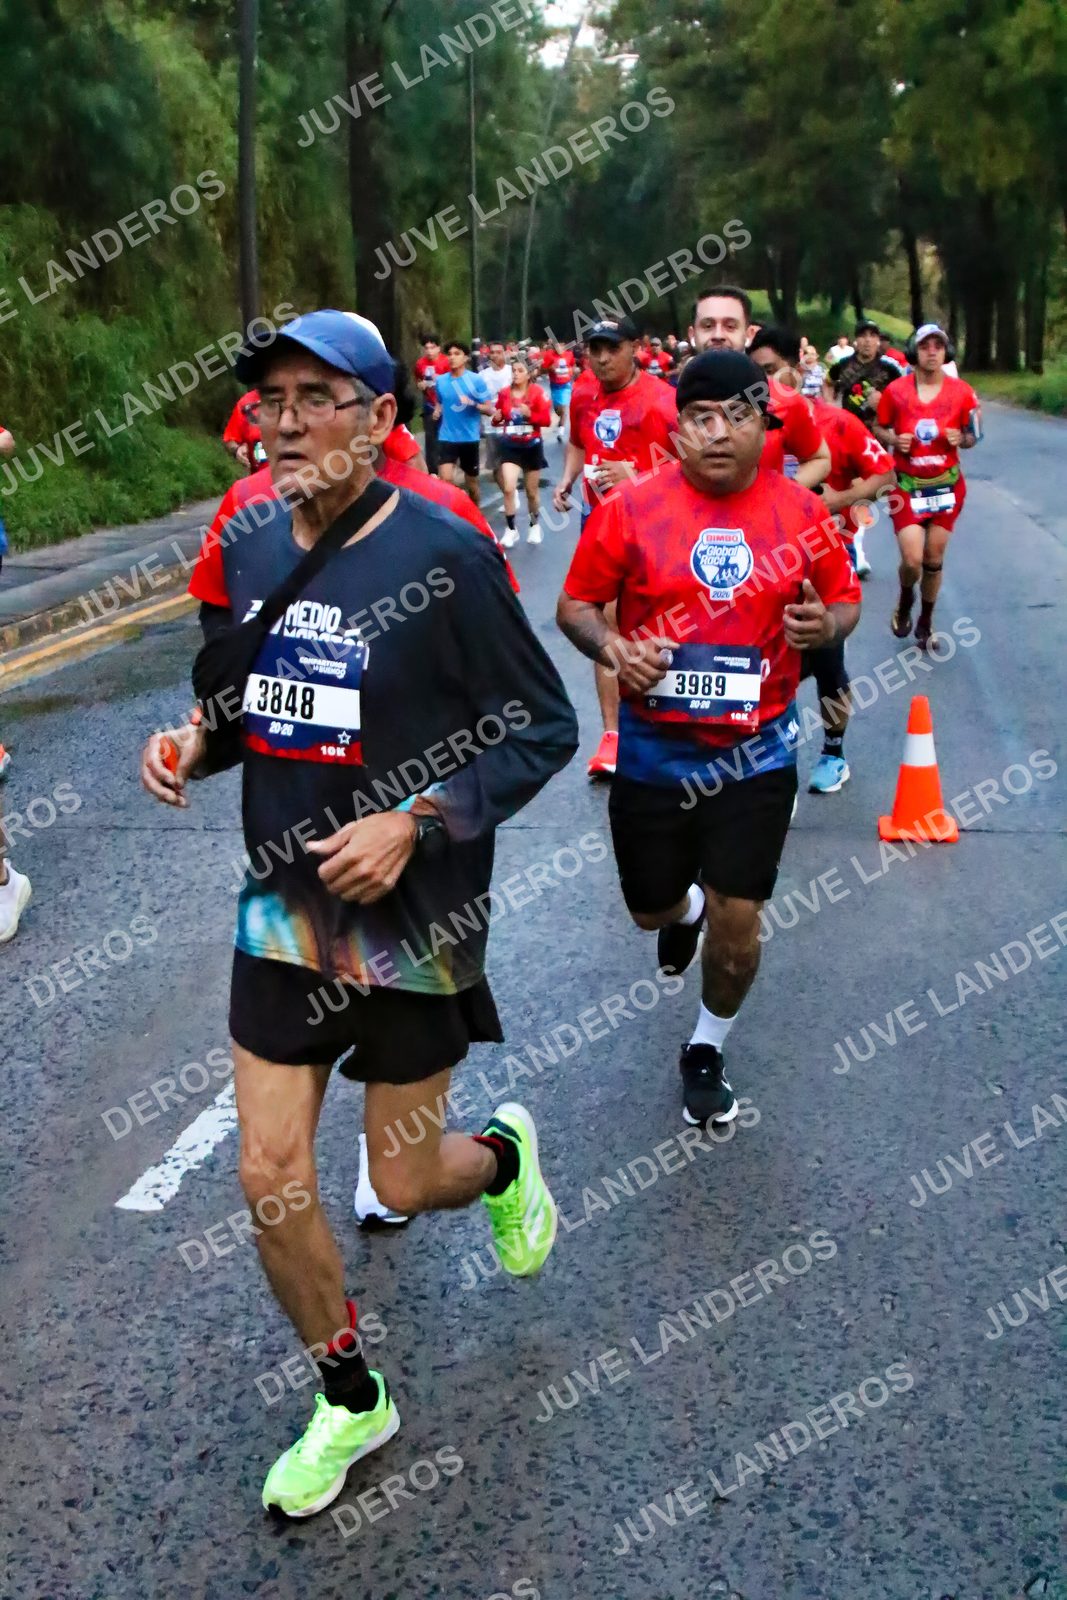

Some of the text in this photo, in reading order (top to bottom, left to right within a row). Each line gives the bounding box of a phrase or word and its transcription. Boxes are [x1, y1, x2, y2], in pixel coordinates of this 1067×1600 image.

[706, 545, 738, 556] Global
[700, 555, 726, 566] Race
[285, 600, 342, 634] MEDIO
[675, 673, 727, 696] 3989
[257, 679, 315, 720] 3848
[730, 713, 749, 721] 10K
[320, 746, 346, 757] 10K
